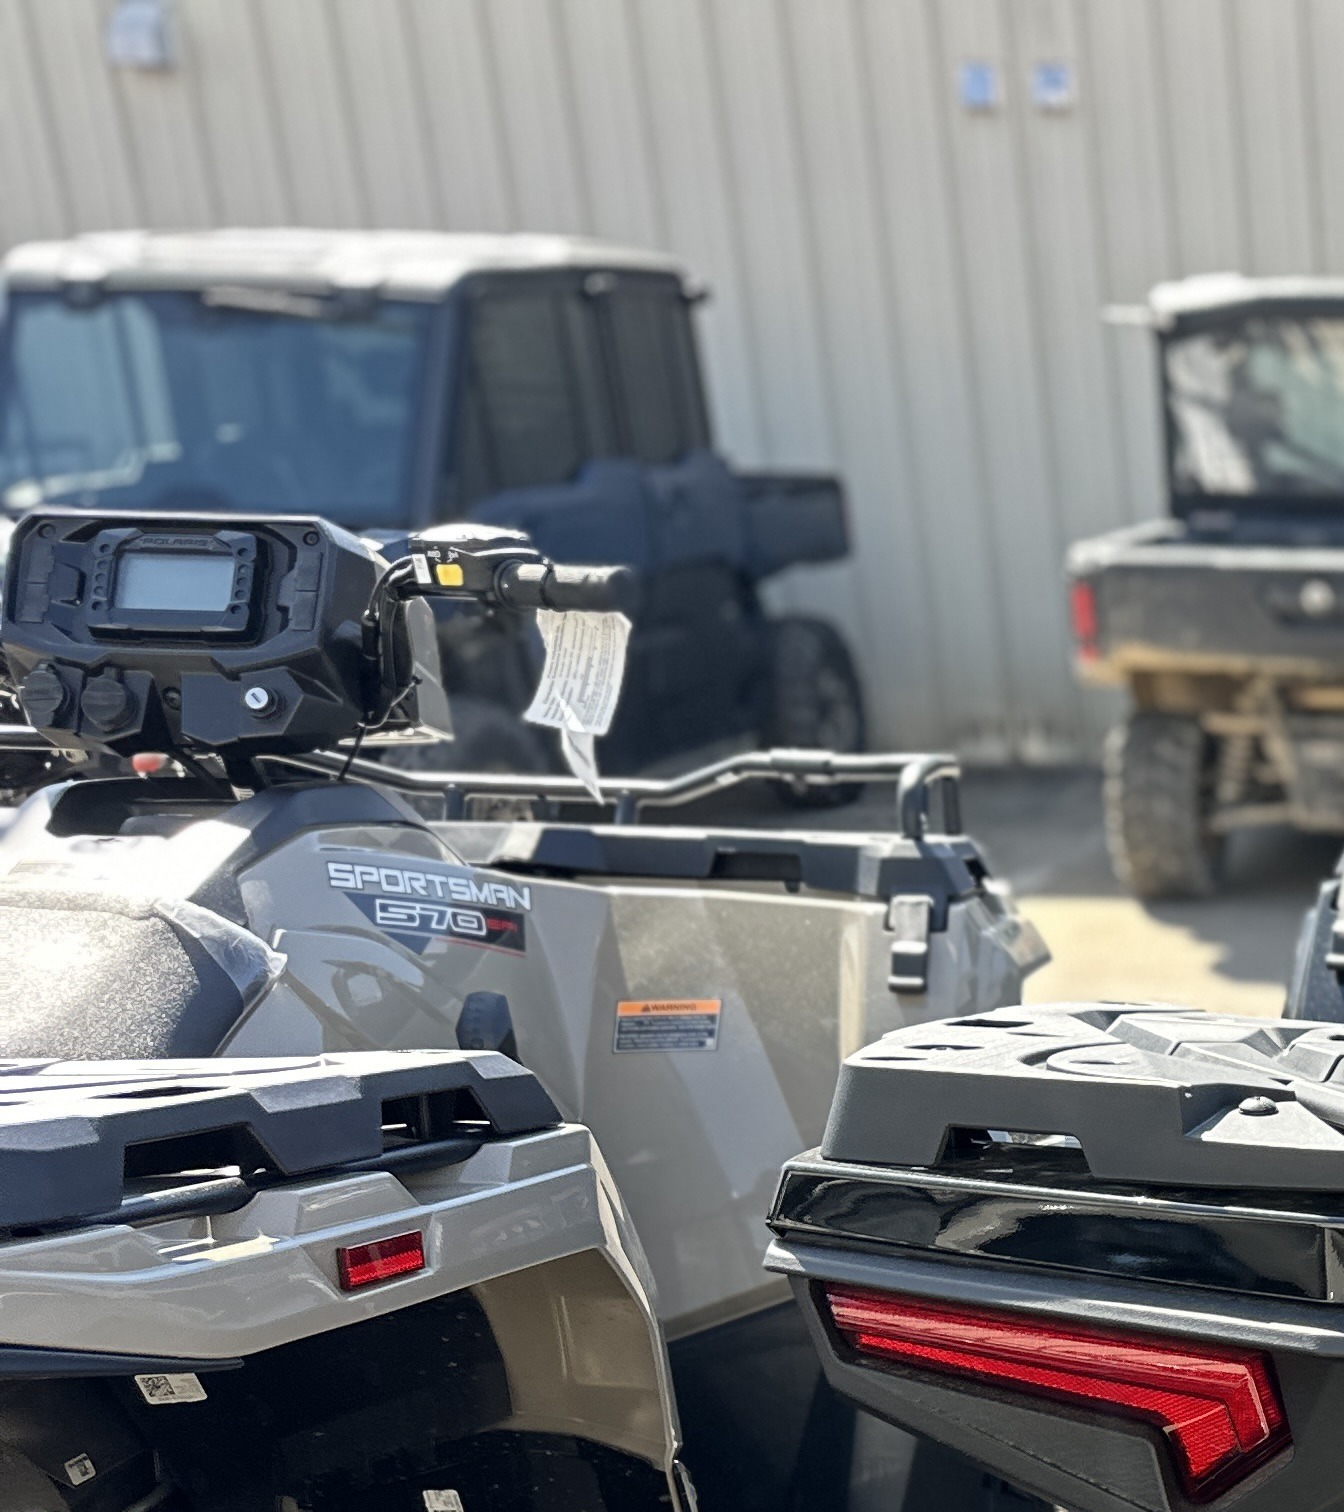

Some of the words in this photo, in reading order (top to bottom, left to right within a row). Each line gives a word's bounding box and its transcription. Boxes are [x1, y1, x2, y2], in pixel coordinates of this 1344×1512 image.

[326, 861, 532, 911] SPORTSMAN
[375, 898, 488, 937] 570
[651, 1003, 697, 1012] WARNING
